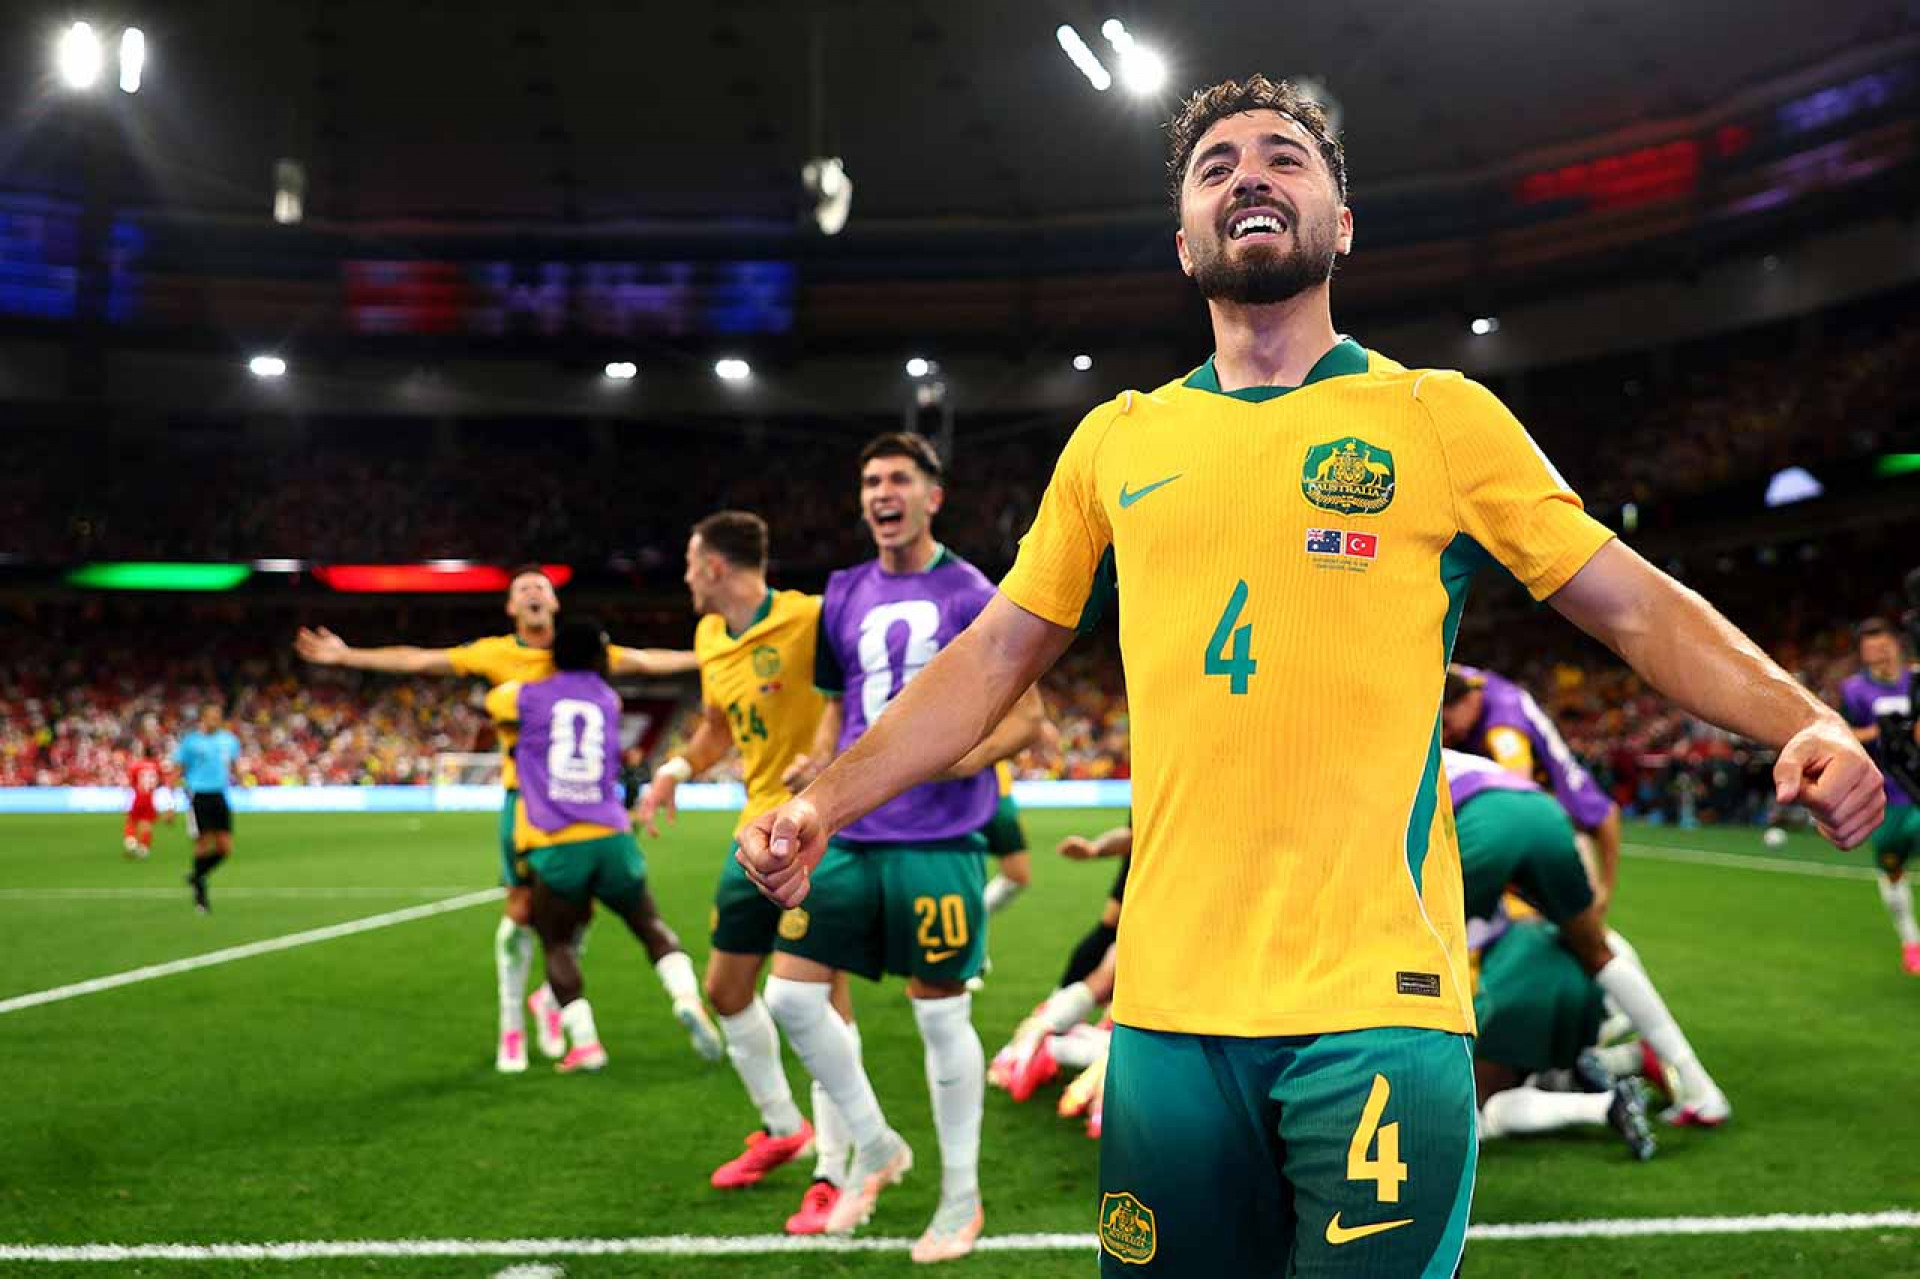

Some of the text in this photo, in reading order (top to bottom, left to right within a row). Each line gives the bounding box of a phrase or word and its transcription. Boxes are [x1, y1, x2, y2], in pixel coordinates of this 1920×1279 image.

[1318, 483, 1380, 496] AUSTRALIA
[1204, 579, 1257, 694] 4
[914, 894, 969, 947] 20
[1347, 1073, 1408, 1202] 4
